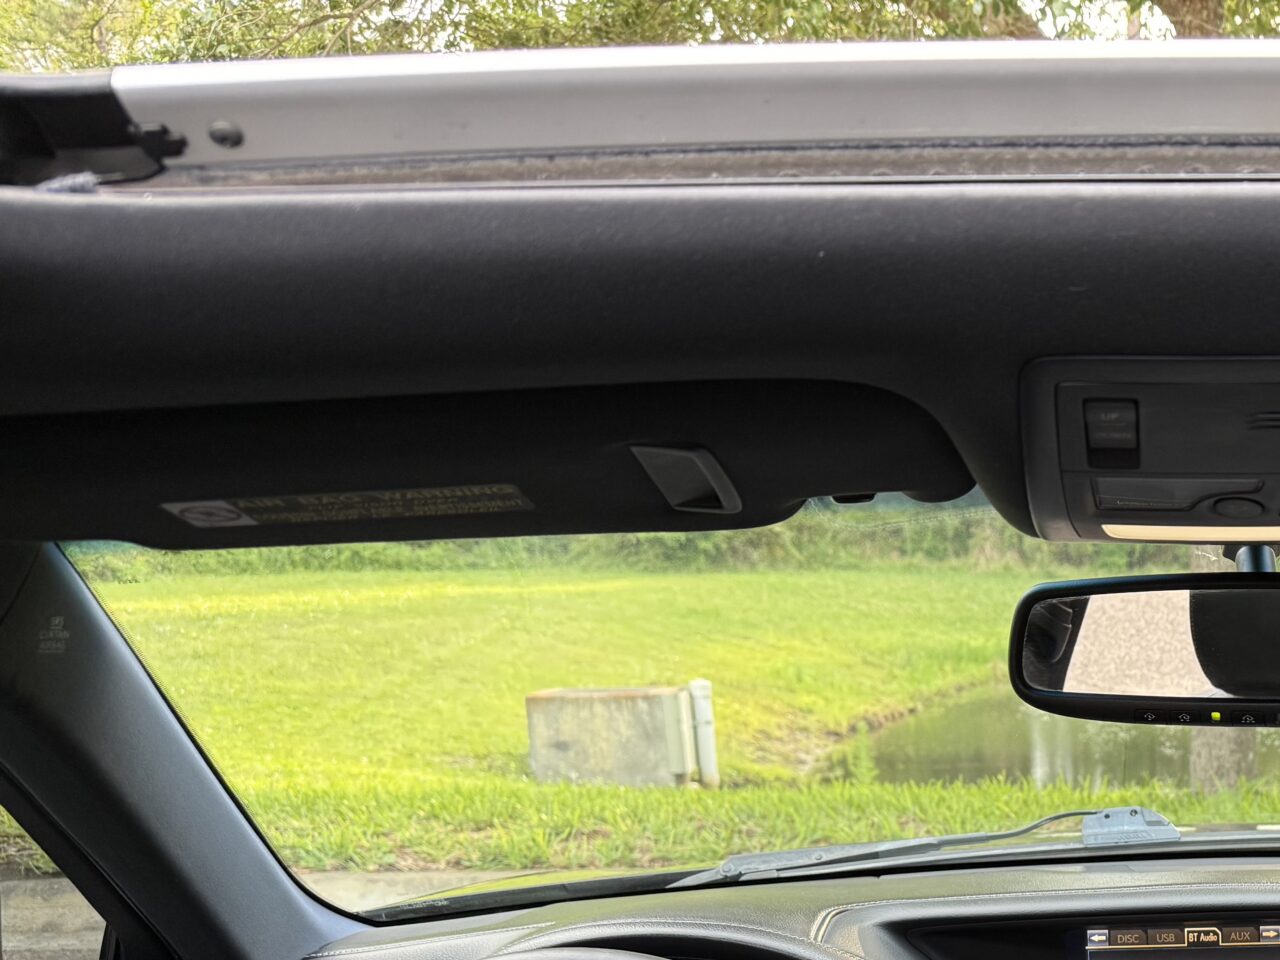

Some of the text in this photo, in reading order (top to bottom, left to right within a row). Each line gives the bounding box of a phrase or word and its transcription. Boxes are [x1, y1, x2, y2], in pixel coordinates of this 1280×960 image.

[1117, 934, 1140, 944] DISC
[1156, 932, 1175, 943] USB
[1188, 932, 1218, 942] BT Audio
[1230, 931, 1251, 942] AUX
